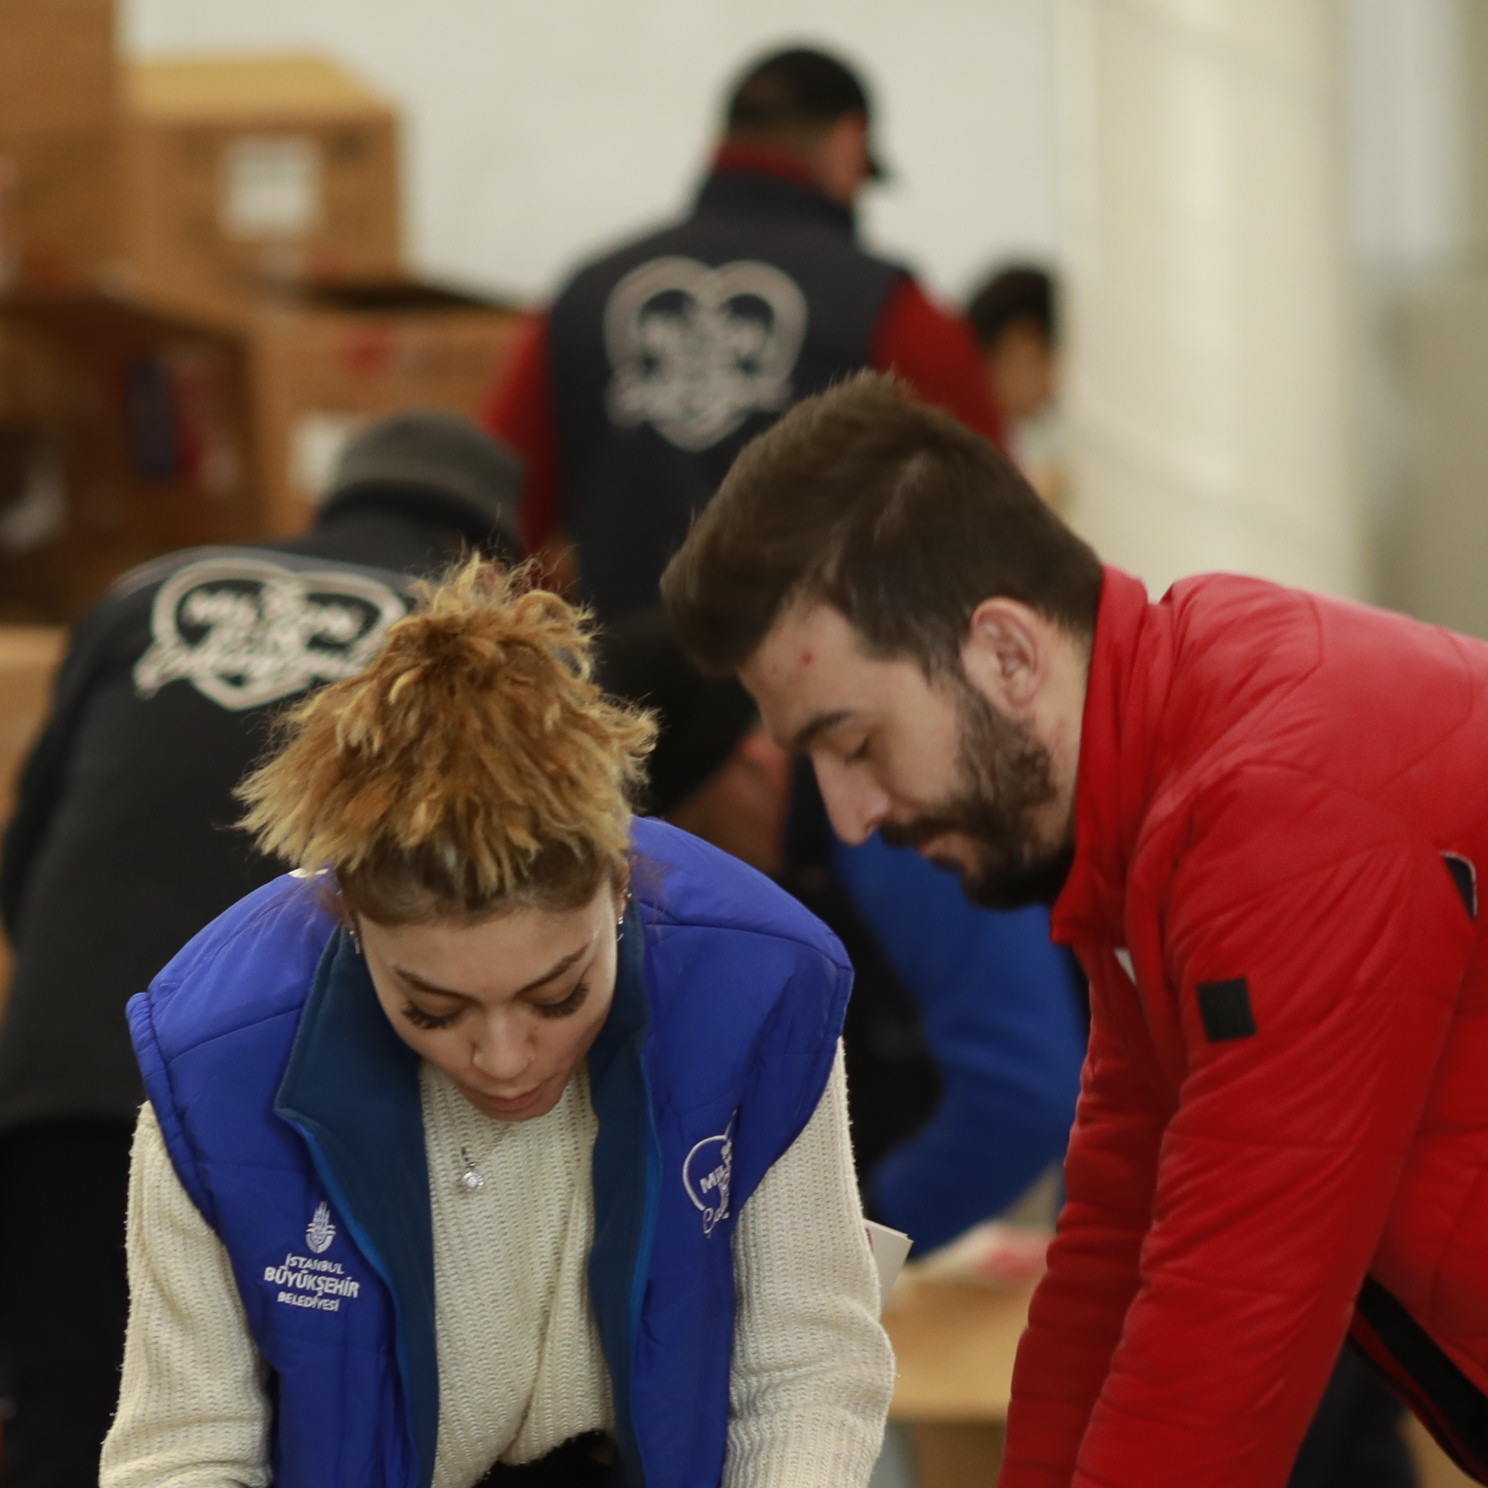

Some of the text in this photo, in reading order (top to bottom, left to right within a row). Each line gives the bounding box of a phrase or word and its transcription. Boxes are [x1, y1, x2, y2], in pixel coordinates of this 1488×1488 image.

[285, 1252, 345, 1275] İSTANBUL
[263, 1265, 361, 1299] BÜYÜKŞEHİR
[277, 1291, 341, 1312] BELEDİYESİ
